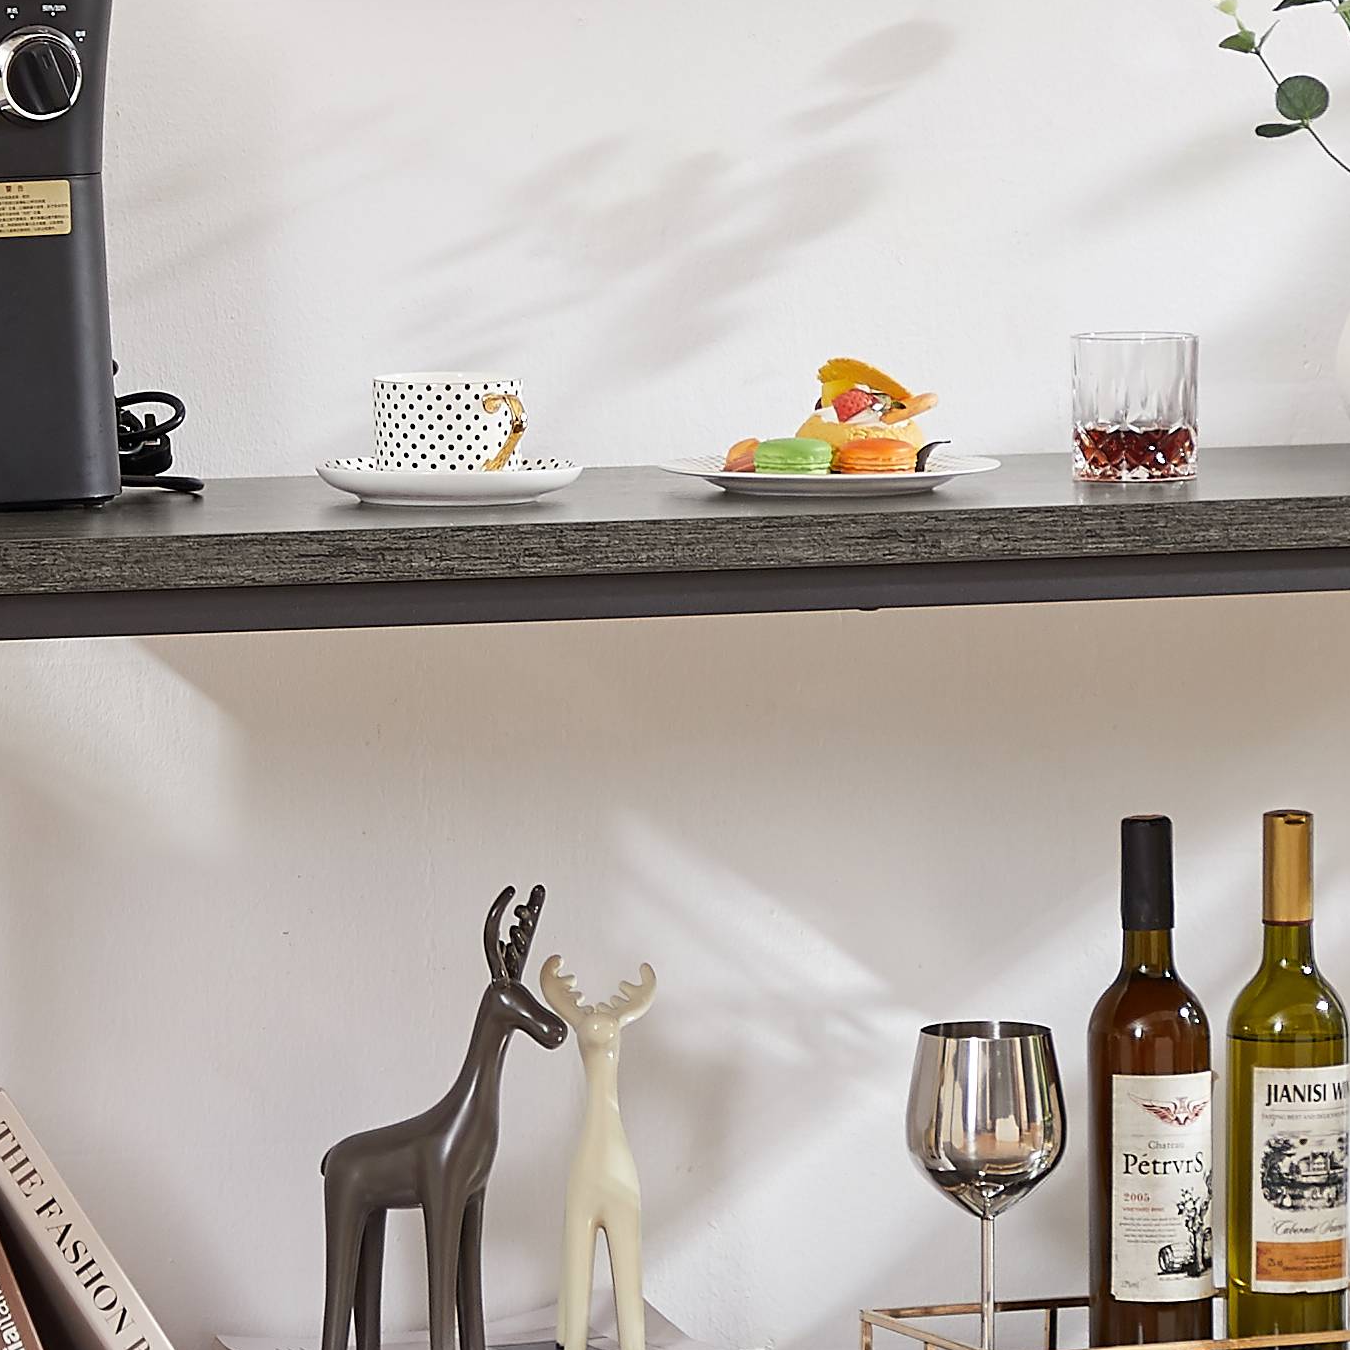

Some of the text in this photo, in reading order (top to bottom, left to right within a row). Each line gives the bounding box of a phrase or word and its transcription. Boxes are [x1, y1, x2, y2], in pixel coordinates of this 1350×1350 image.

[1265, 1083, 1327, 1106] JIANISI
[1123, 1193, 1150, 1202] 2005
[34, 1194, 135, 1336] FASHON
